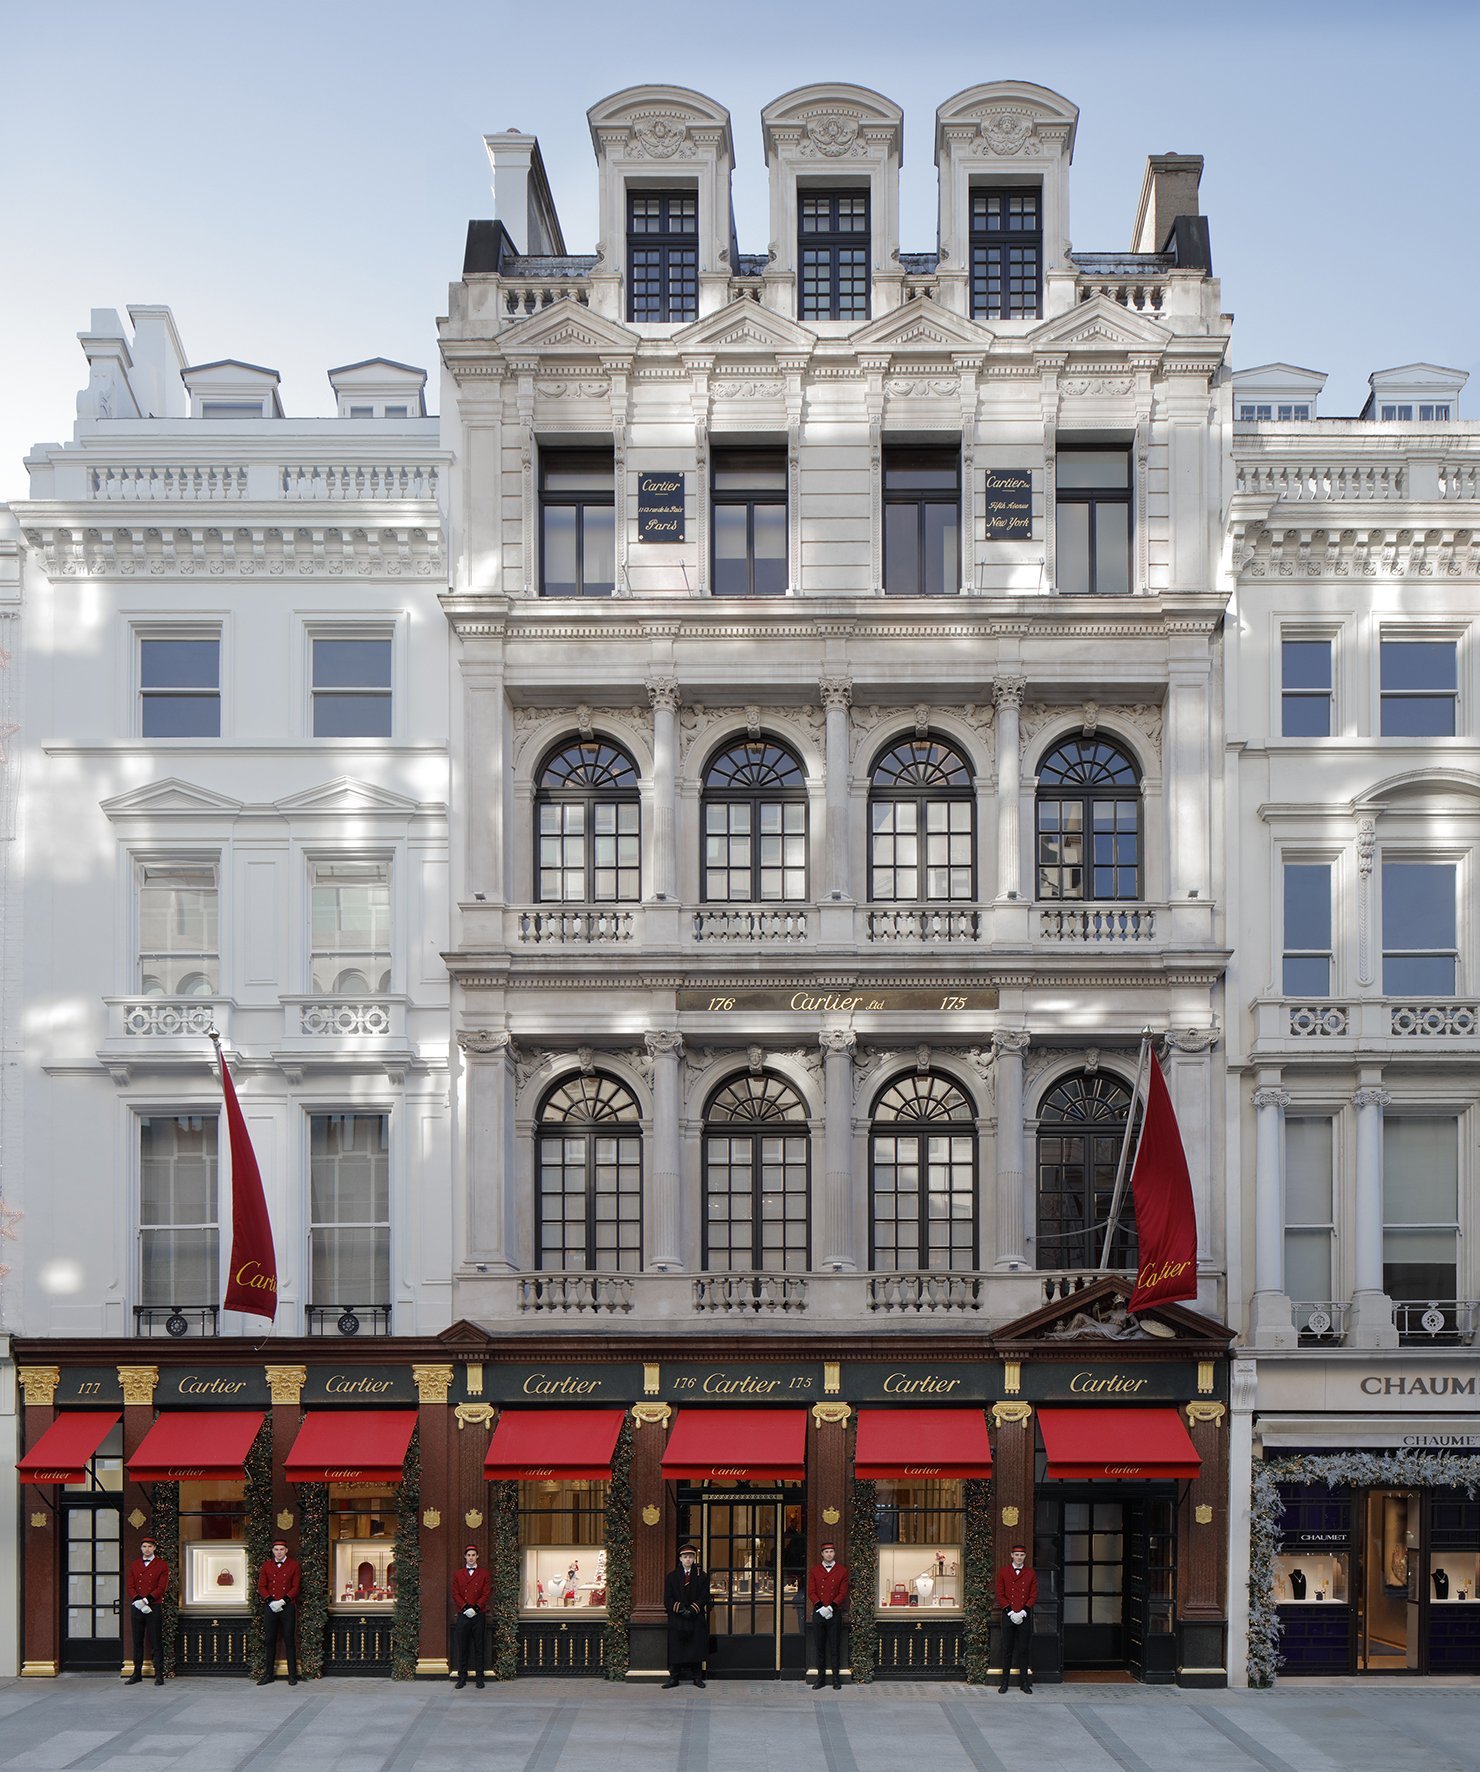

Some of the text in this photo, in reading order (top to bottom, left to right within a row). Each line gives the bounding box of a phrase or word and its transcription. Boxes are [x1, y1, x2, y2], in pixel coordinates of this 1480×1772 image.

[642, 479, 680, 491] Cartier
[986, 475, 1024, 488] Cartier
[645, 518, 677, 530] Paris
[986, 516, 1030, 531] New York
[706, 997, 736, 1010] 176
[790, 992, 863, 1011] Cartier
[939, 996, 968, 1010] 175
[236, 1260, 277, 1293] Carti
[1137, 1260, 1191, 1289] Catier
[77, 1382, 101, 1394] 177
[178, 1375, 247, 1394] Cartier
[325, 1374, 394, 1394] Cartier
[522, 1373, 602, 1395] Cartier
[673, 1372, 813, 1394] 176 Cartier 175
[883, 1372, 961, 1394] Cartier
[1069, 1372, 1148, 1393] Cartier
[1360, 1376, 1480, 1395] CHAUM
[33, 1468, 72, 1481] Cartier
[167, 1466, 206, 1477] Cartier
[324, 1467, 362, 1478] Cartier
[711, 1466, 750, 1477] Cartier
[904, 1464, 942, 1475] Cartier
[1104, 1464, 1142, 1475] Cartier
